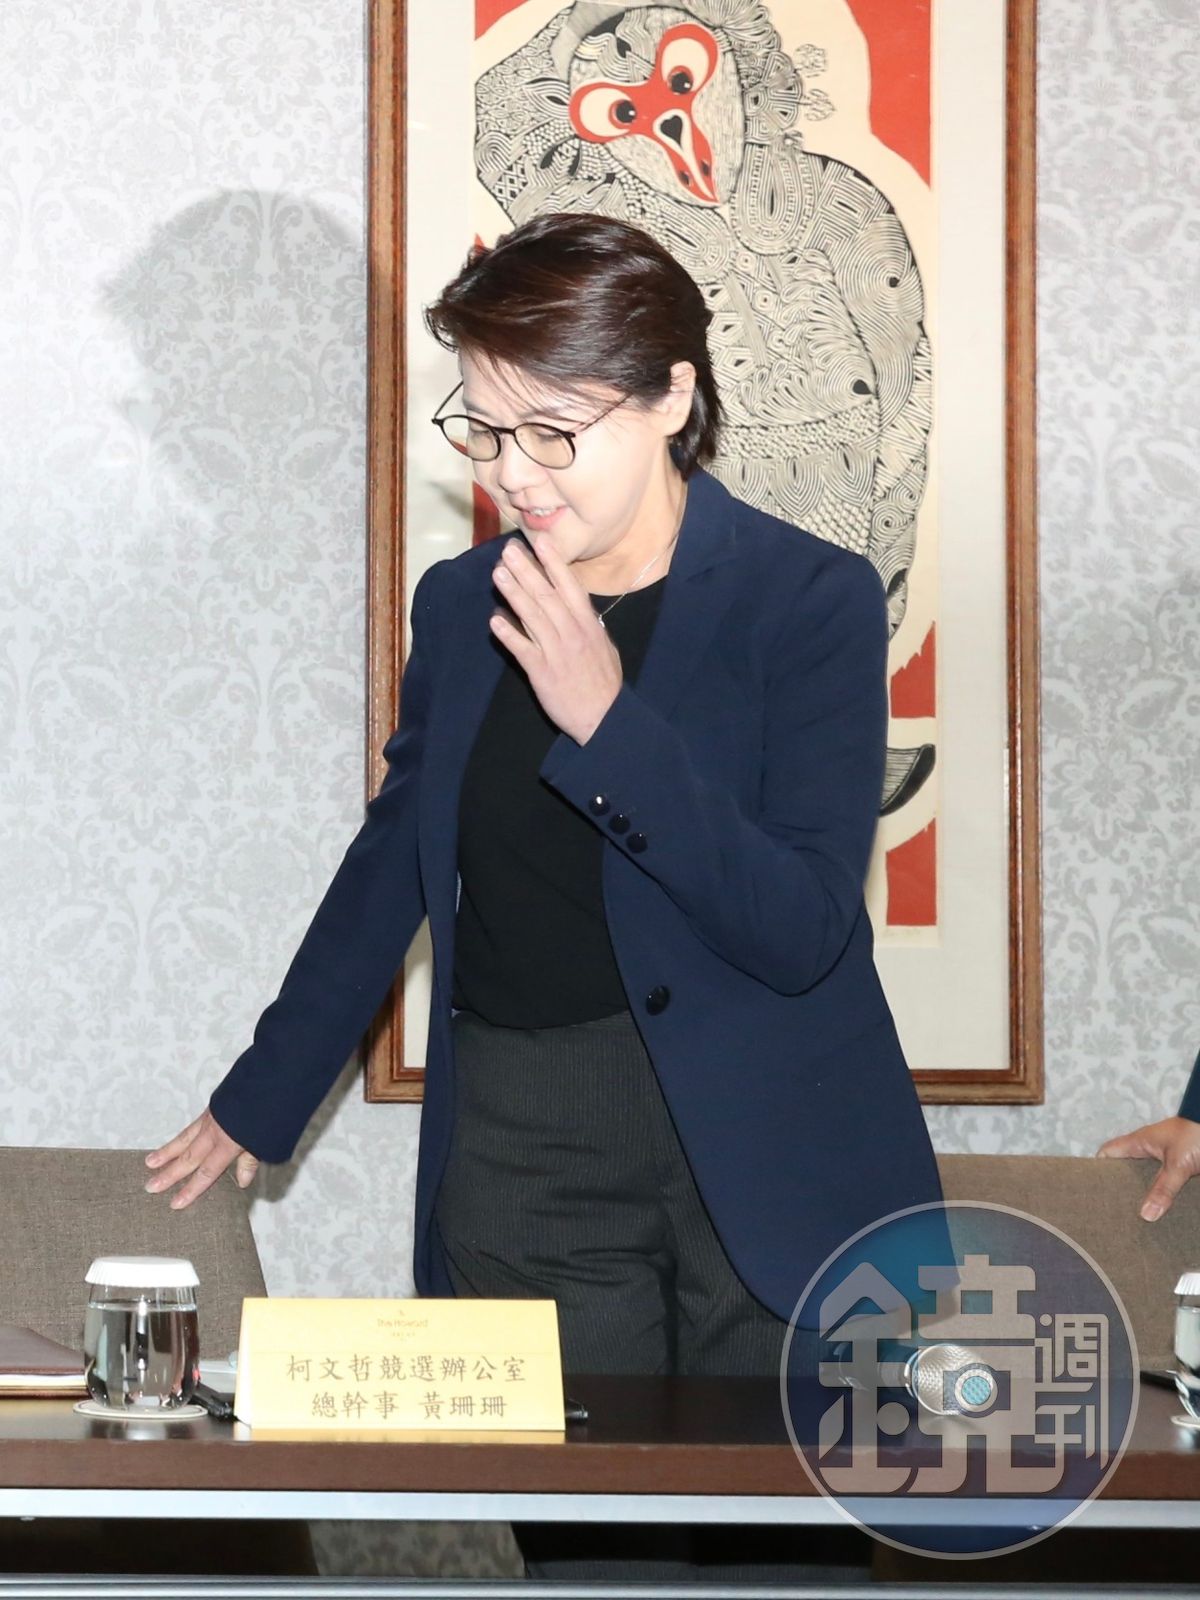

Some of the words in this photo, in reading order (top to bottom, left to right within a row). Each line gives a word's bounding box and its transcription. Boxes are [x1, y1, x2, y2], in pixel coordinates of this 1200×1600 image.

[287, 1354, 526, 1382] 柯文哲競選辦公室
[311, 1390, 400, 1420] 總幹事
[420, 1391, 508, 1420] 黃珊珊
